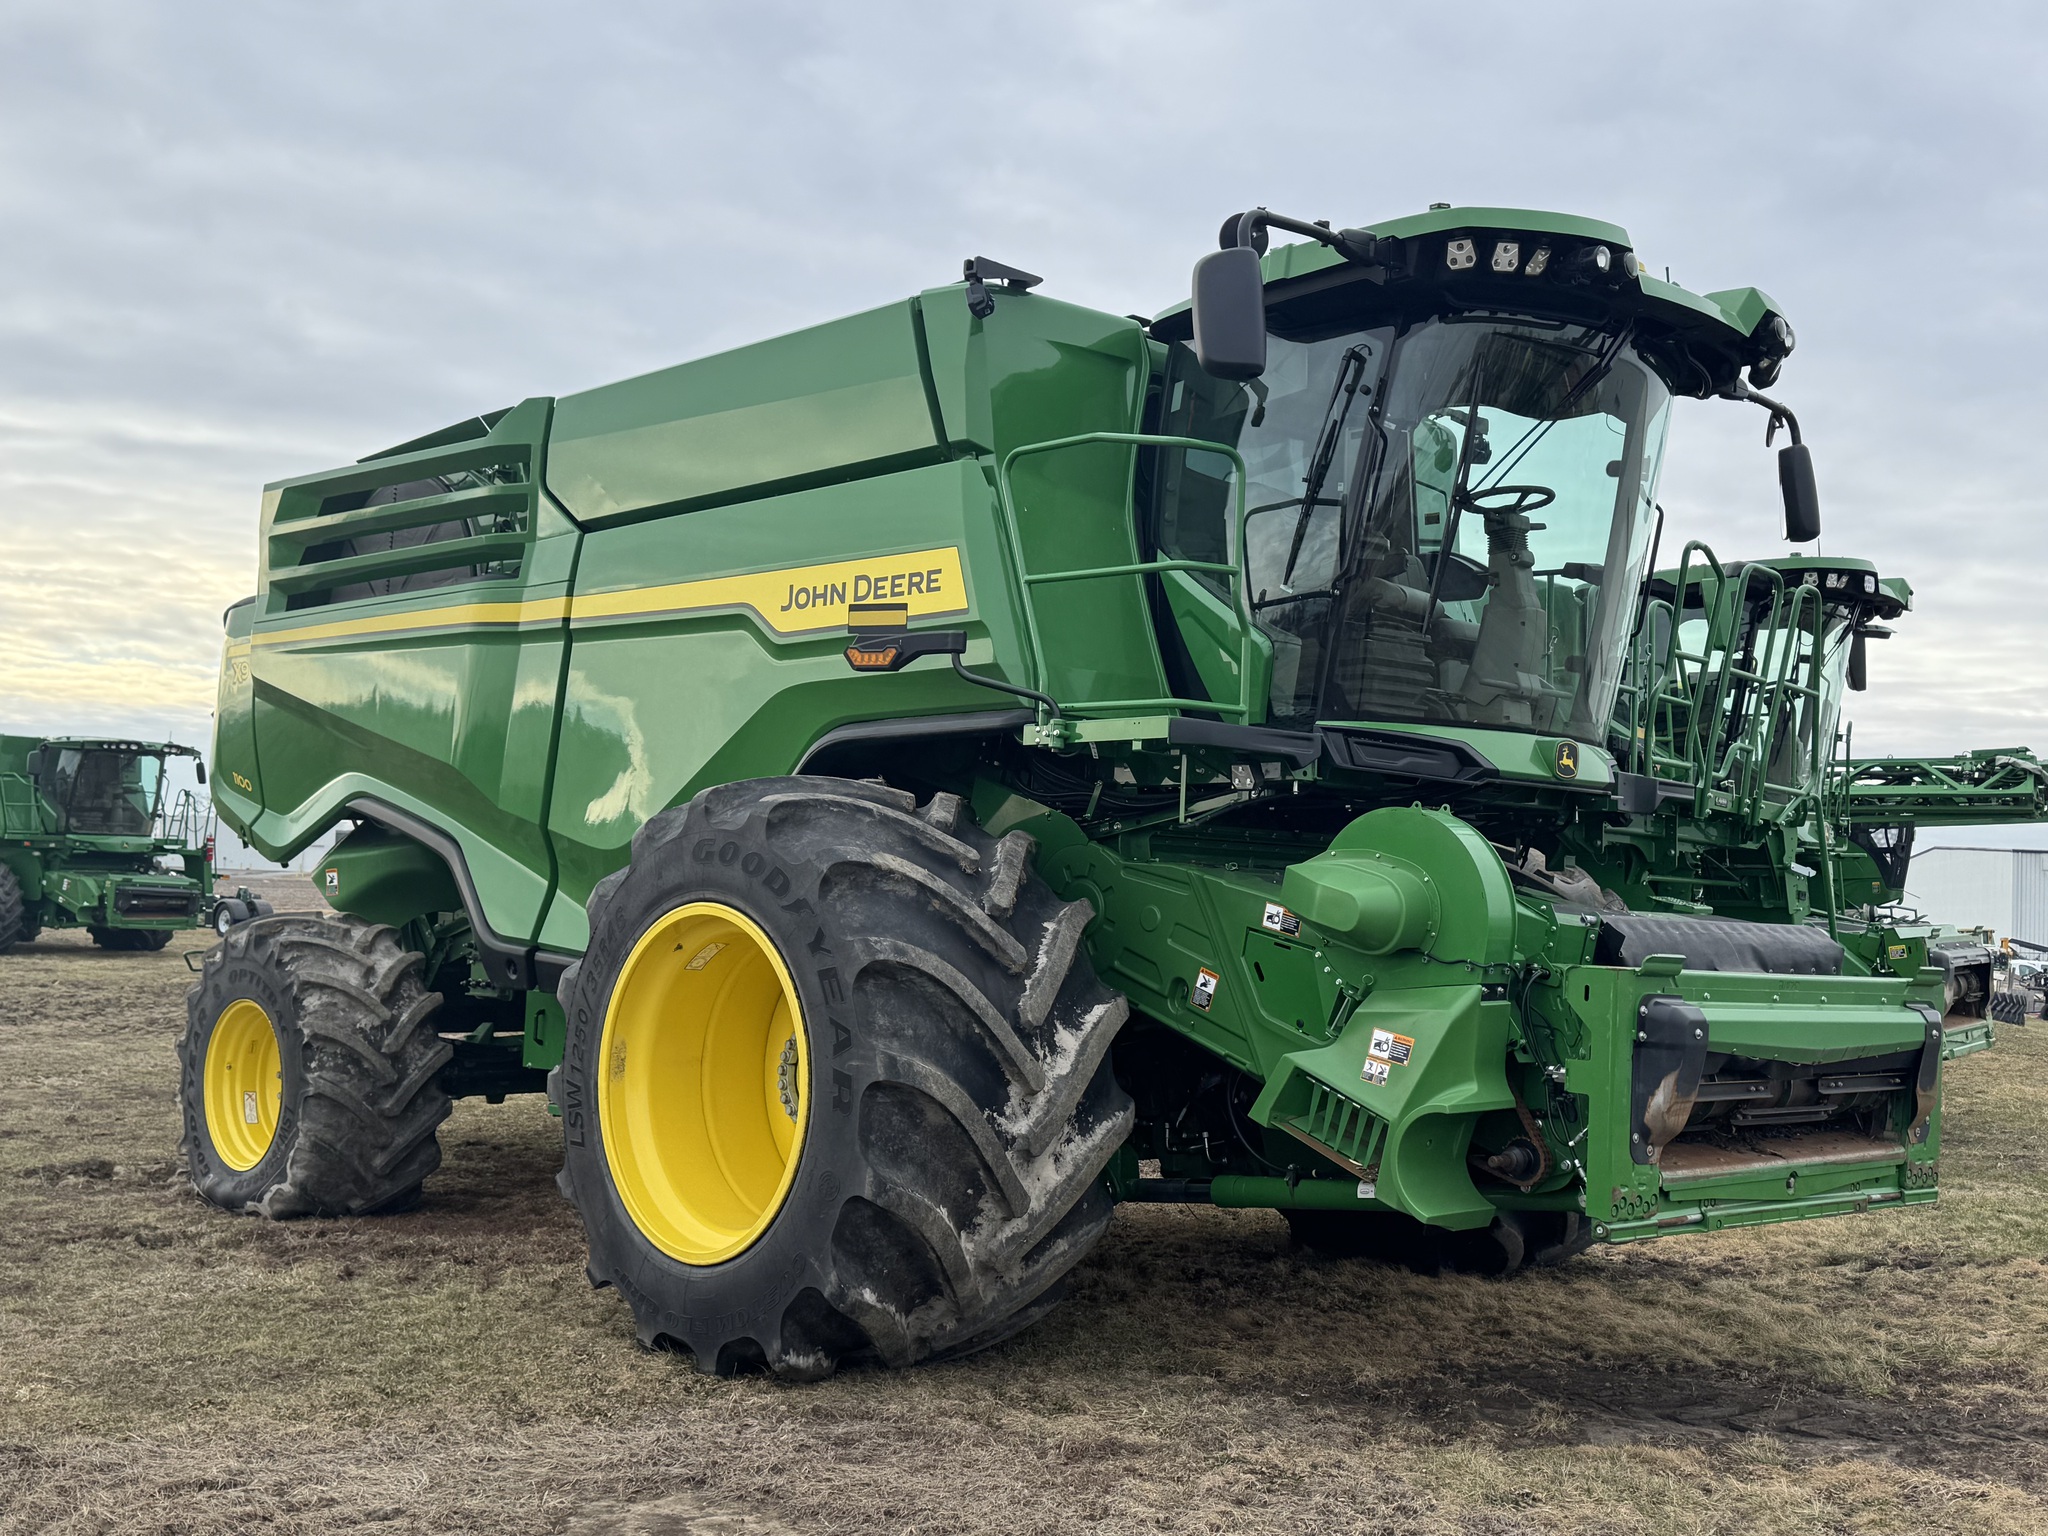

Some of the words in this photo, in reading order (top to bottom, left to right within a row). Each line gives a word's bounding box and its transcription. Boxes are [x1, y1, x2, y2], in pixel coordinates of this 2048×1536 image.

[780, 581, 847, 612] JOHN
[853, 568, 943, 603] DEERE
[231, 660, 251, 686] X9
[232, 771, 253, 792] 1100
[692, 837, 855, 1117] GOODYEAR
